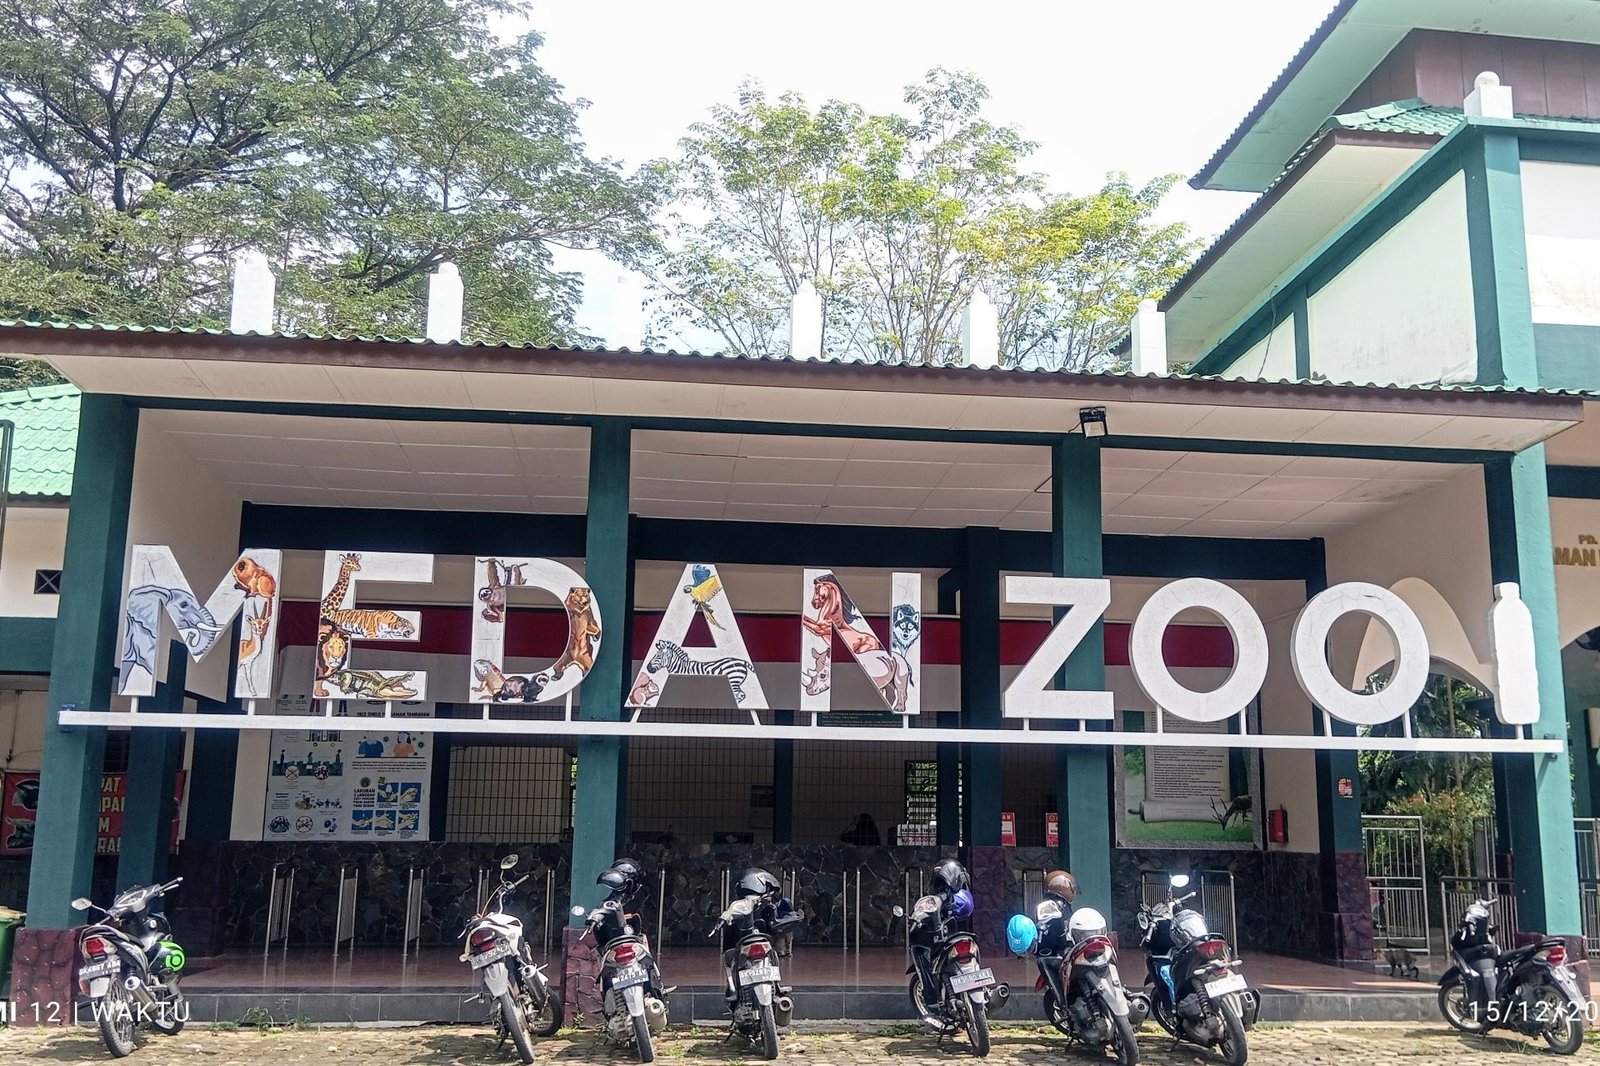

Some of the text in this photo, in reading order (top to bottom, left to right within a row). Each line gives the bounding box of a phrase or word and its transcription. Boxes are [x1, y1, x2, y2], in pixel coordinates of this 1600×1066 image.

[1553, 547, 1596, 567] MAN
[119, 543, 1431, 725] MEDAN ZOO
[101, 777, 122, 793] AT
